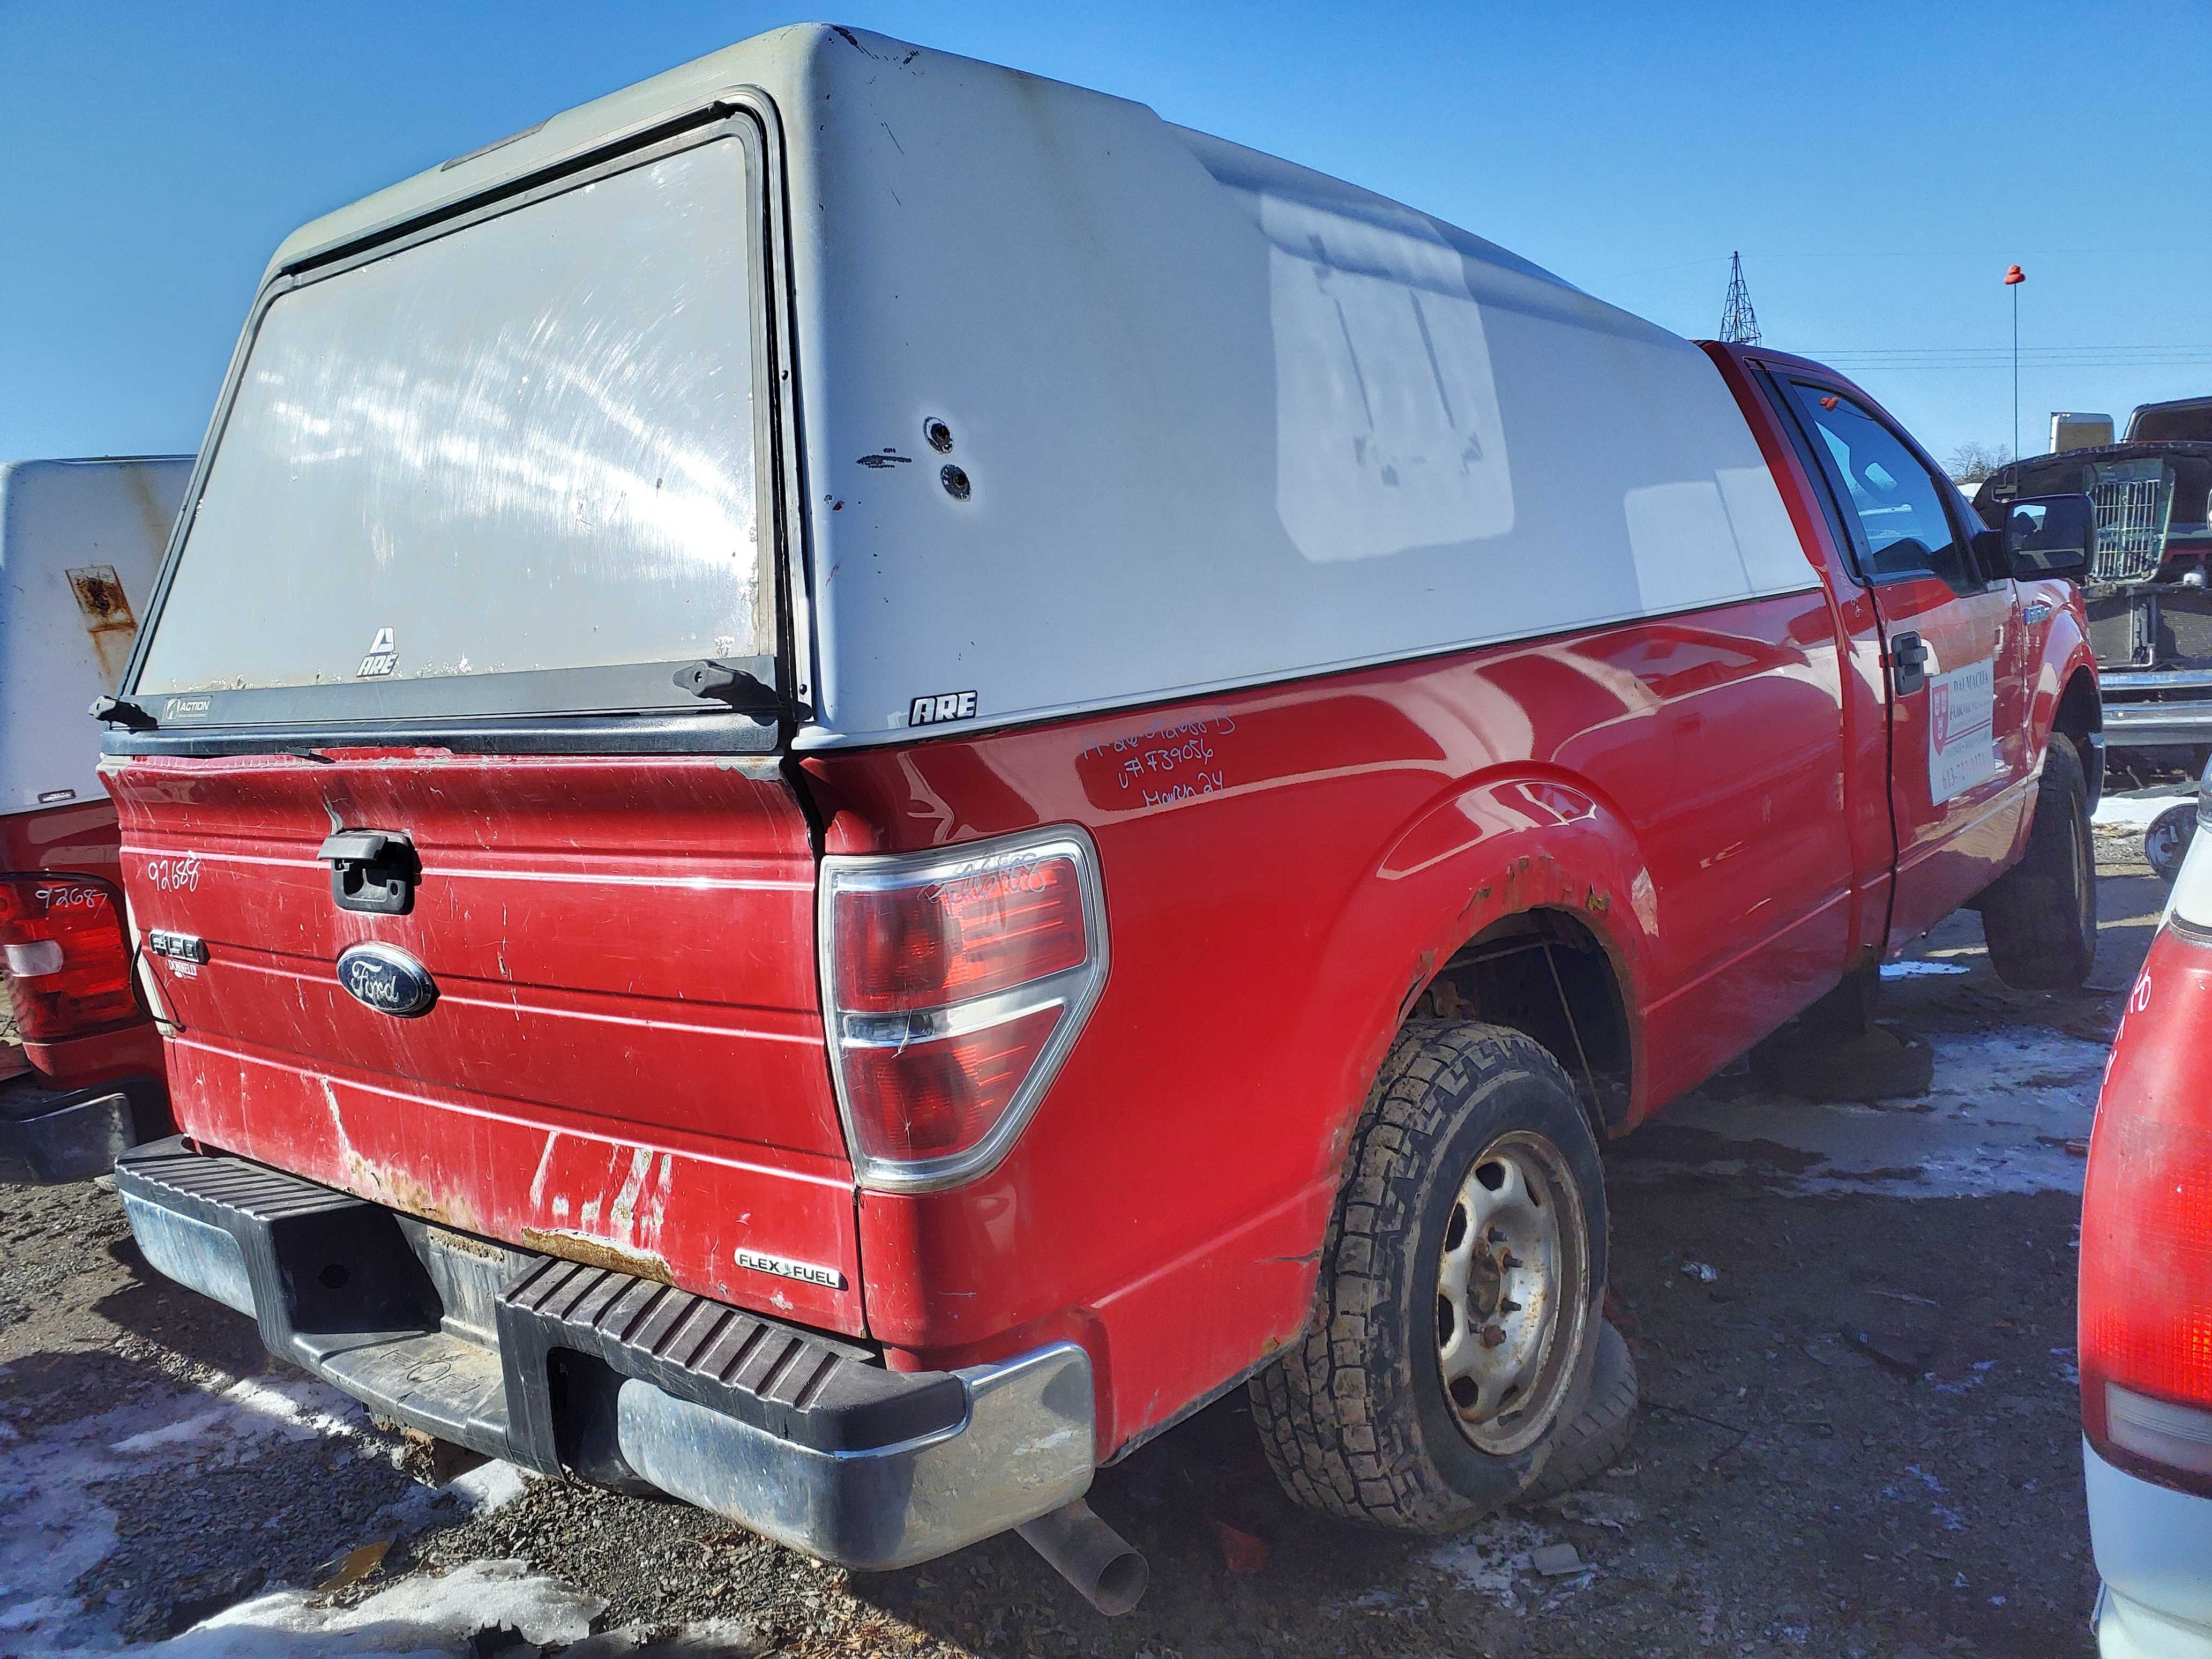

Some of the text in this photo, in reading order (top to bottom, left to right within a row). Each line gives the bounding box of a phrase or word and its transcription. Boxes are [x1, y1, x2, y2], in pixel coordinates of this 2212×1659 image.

[356, 653, 399, 677] ARE
[180, 701, 210, 712] ACTION
[910, 691, 977, 726] ARE
[148, 858, 200, 893] 92688
[35, 887, 108, 918] 92687
[167, 959, 198, 976] DONNELLY
[350, 960, 399, 1002] Ford
[739, 1254, 836, 1286] FLEX FUEL
